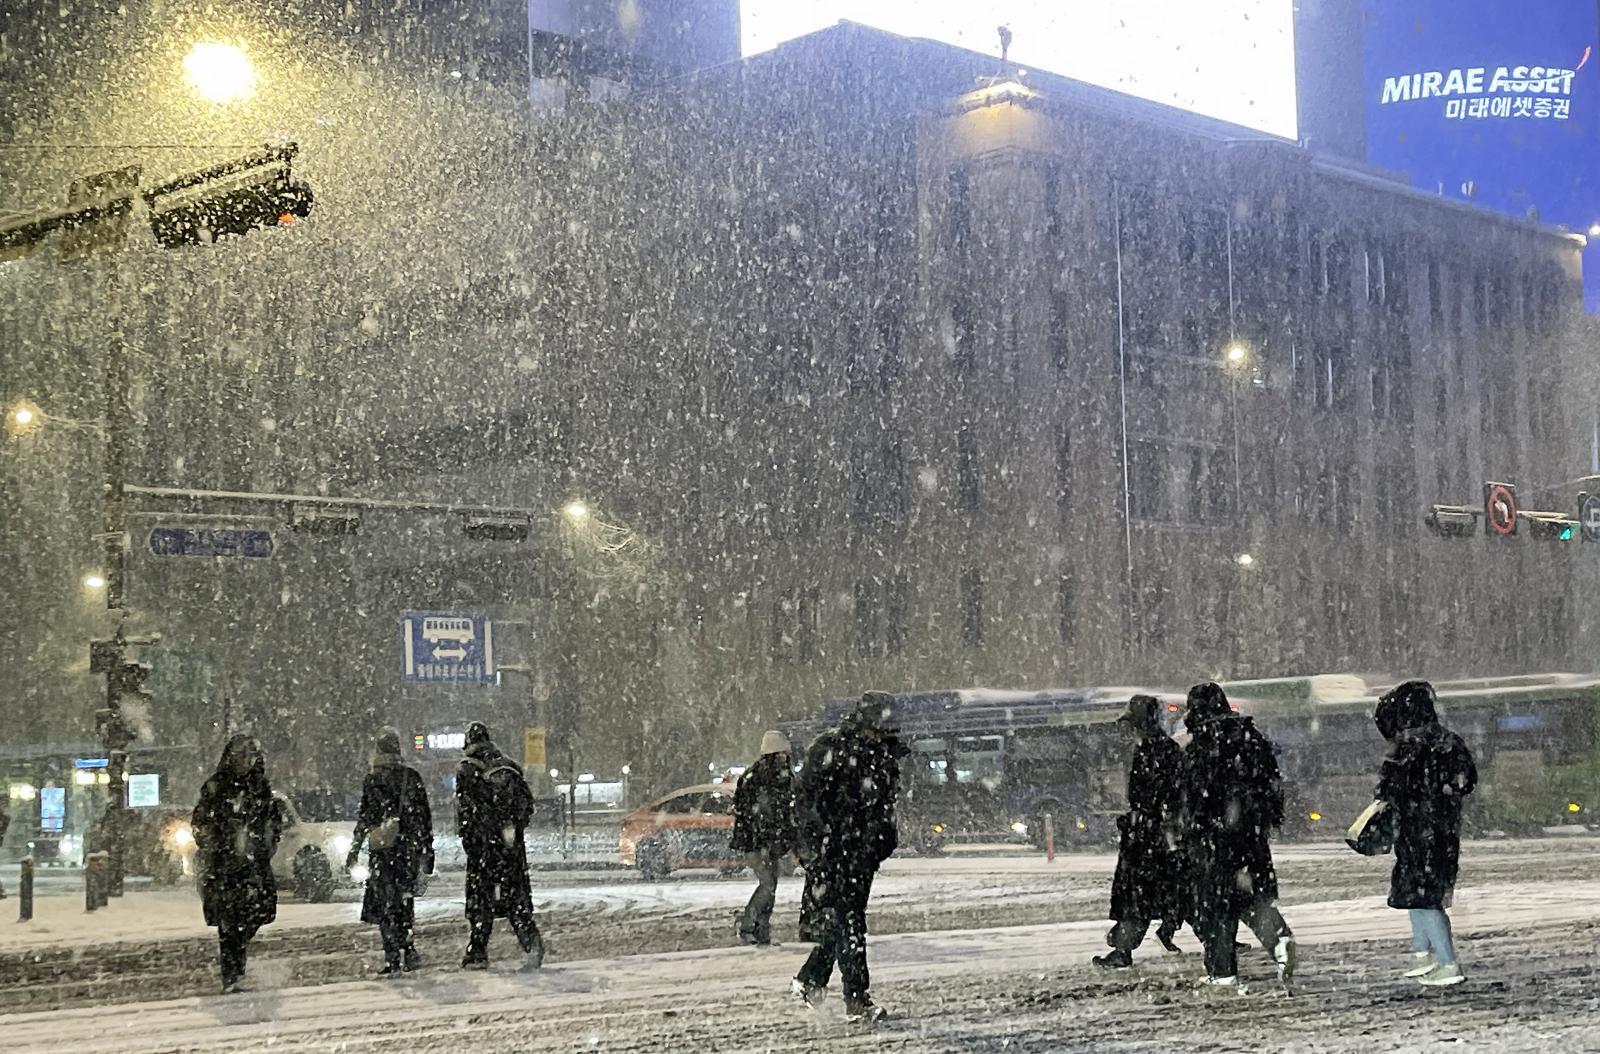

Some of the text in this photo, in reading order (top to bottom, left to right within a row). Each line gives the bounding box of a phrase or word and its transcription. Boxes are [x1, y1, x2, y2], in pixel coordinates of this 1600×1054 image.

[1381, 65, 1575, 104] MIRAE ASSET
[1445, 97, 1570, 119] 미래에셋증권
